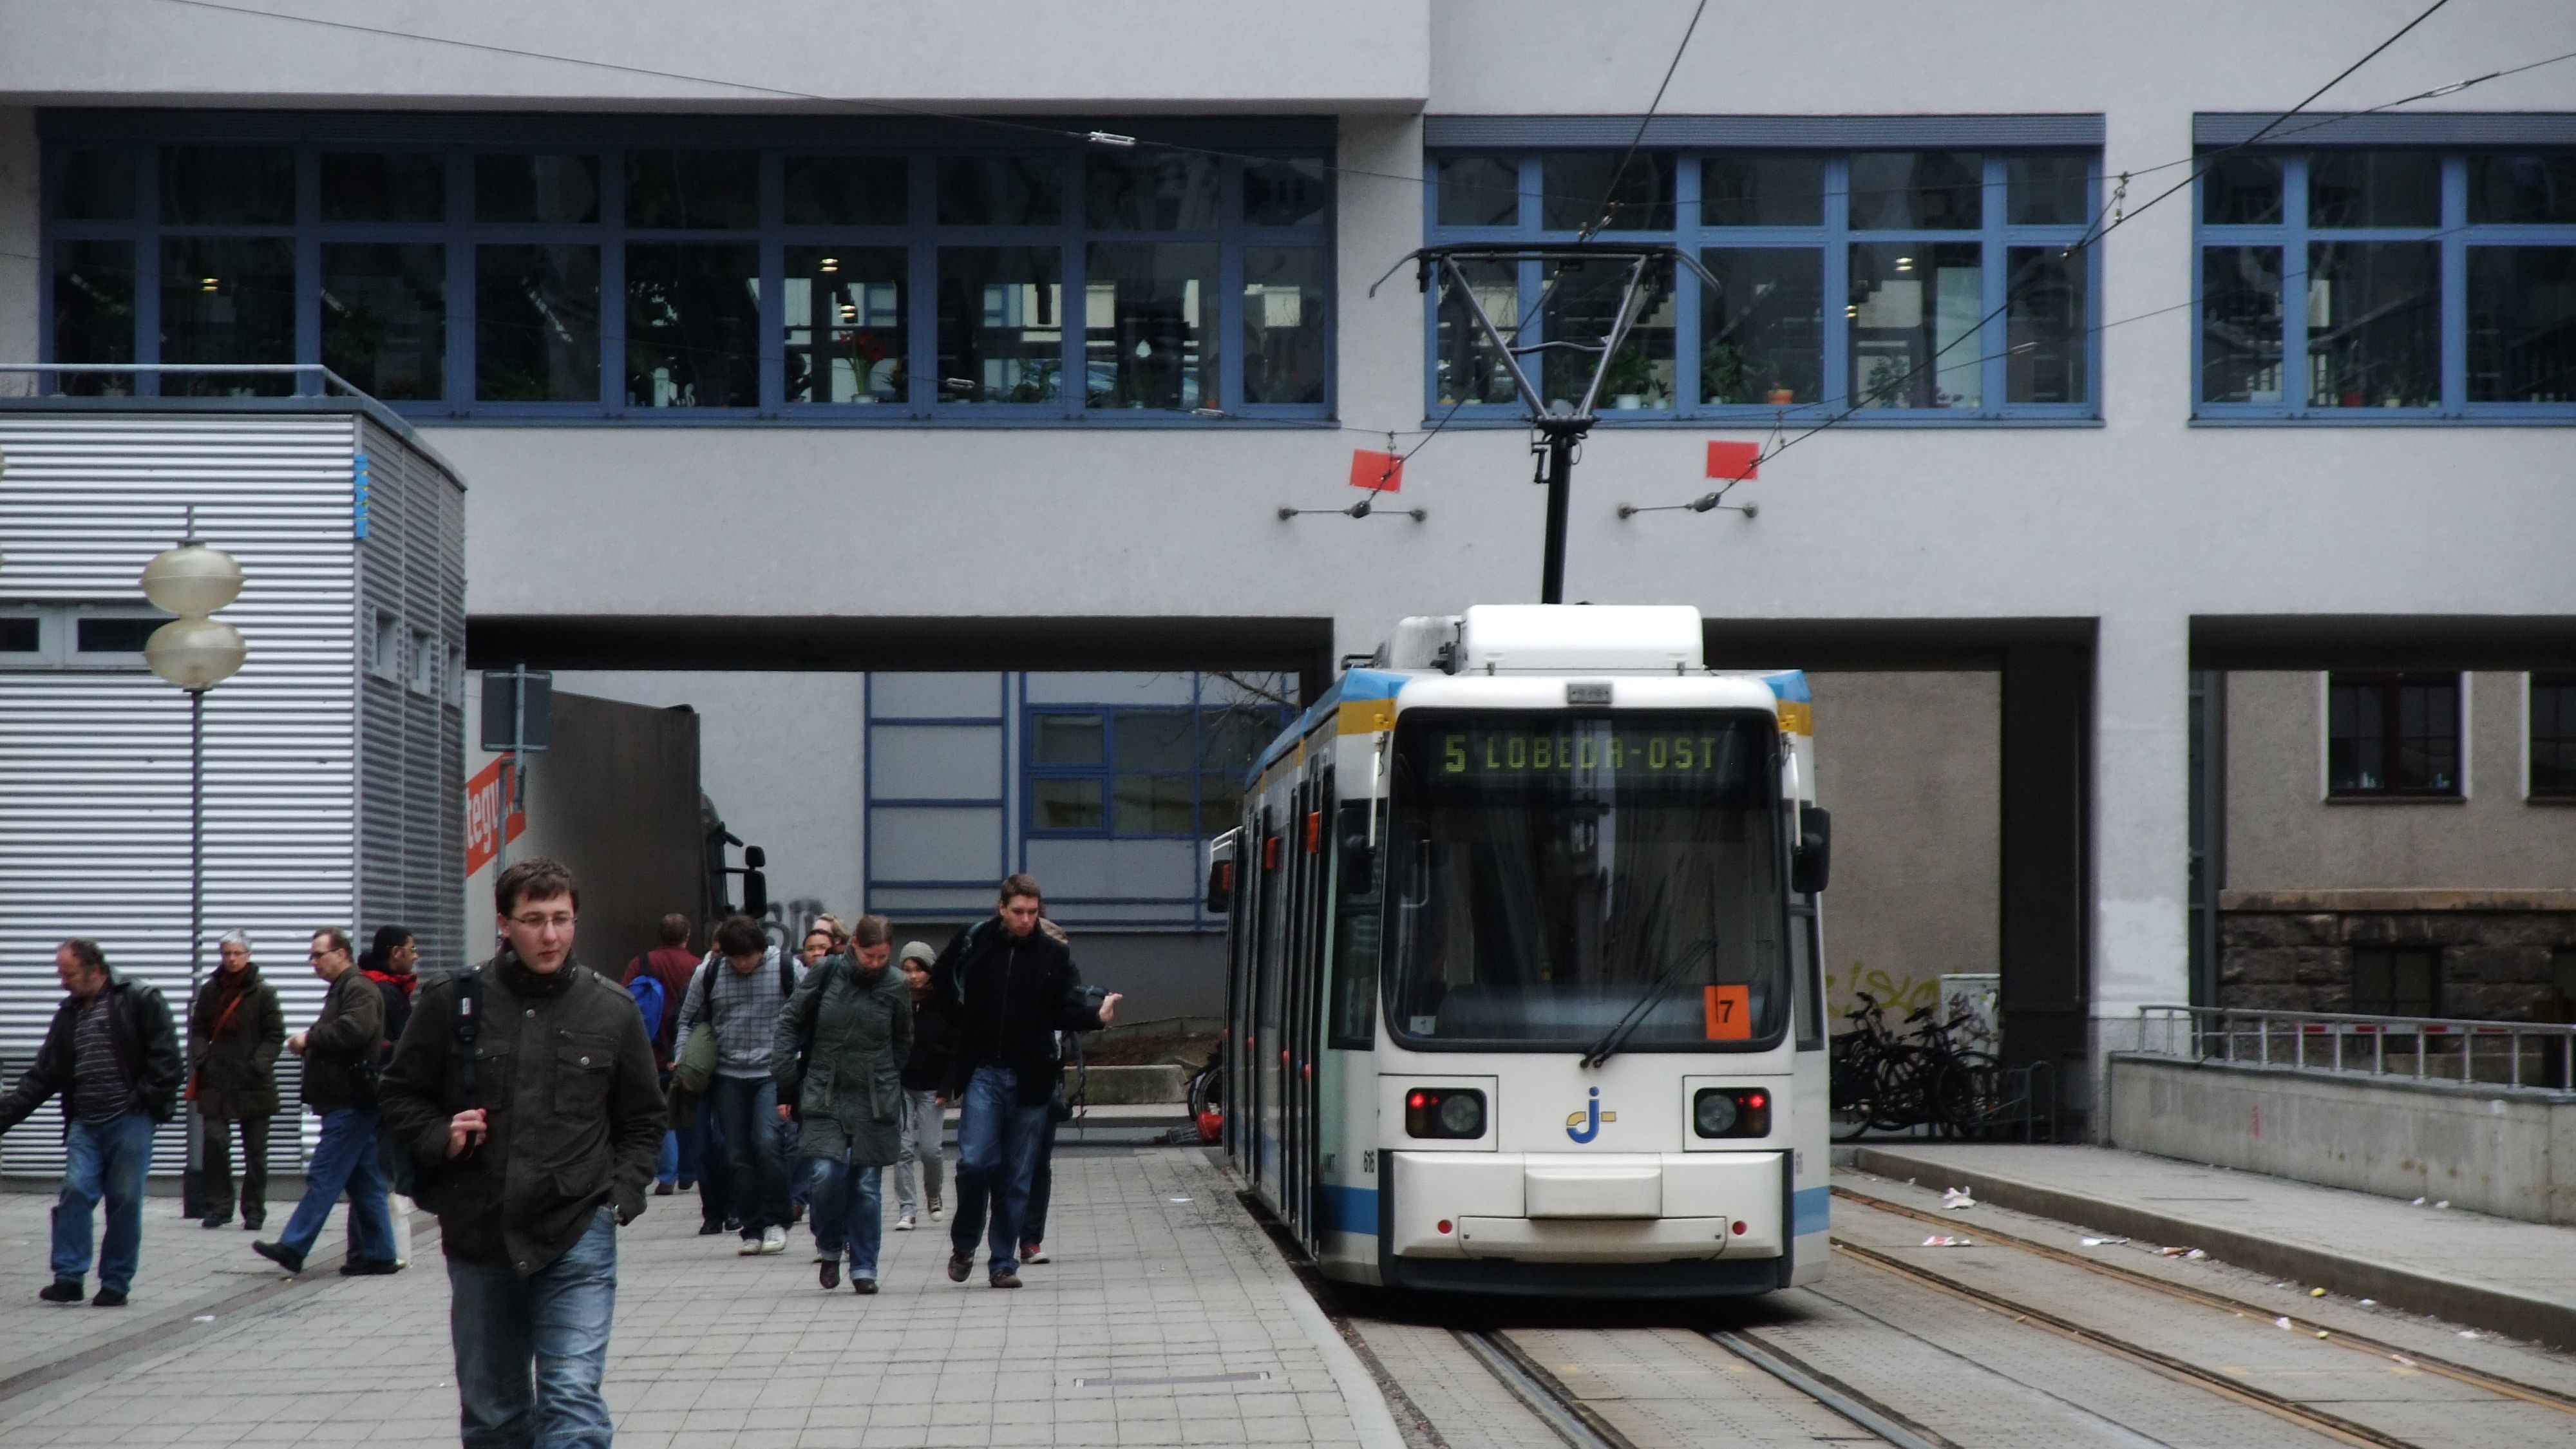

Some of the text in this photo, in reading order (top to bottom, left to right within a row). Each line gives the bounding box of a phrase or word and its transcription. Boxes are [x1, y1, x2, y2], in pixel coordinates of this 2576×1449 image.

[1444, 734, 1716, 772] 5 LOBEDA-OST
[465, 778, 504, 854] tegu
[1719, 999, 1735, 1023] 7
[1363, 1150, 1375, 1173] 616
